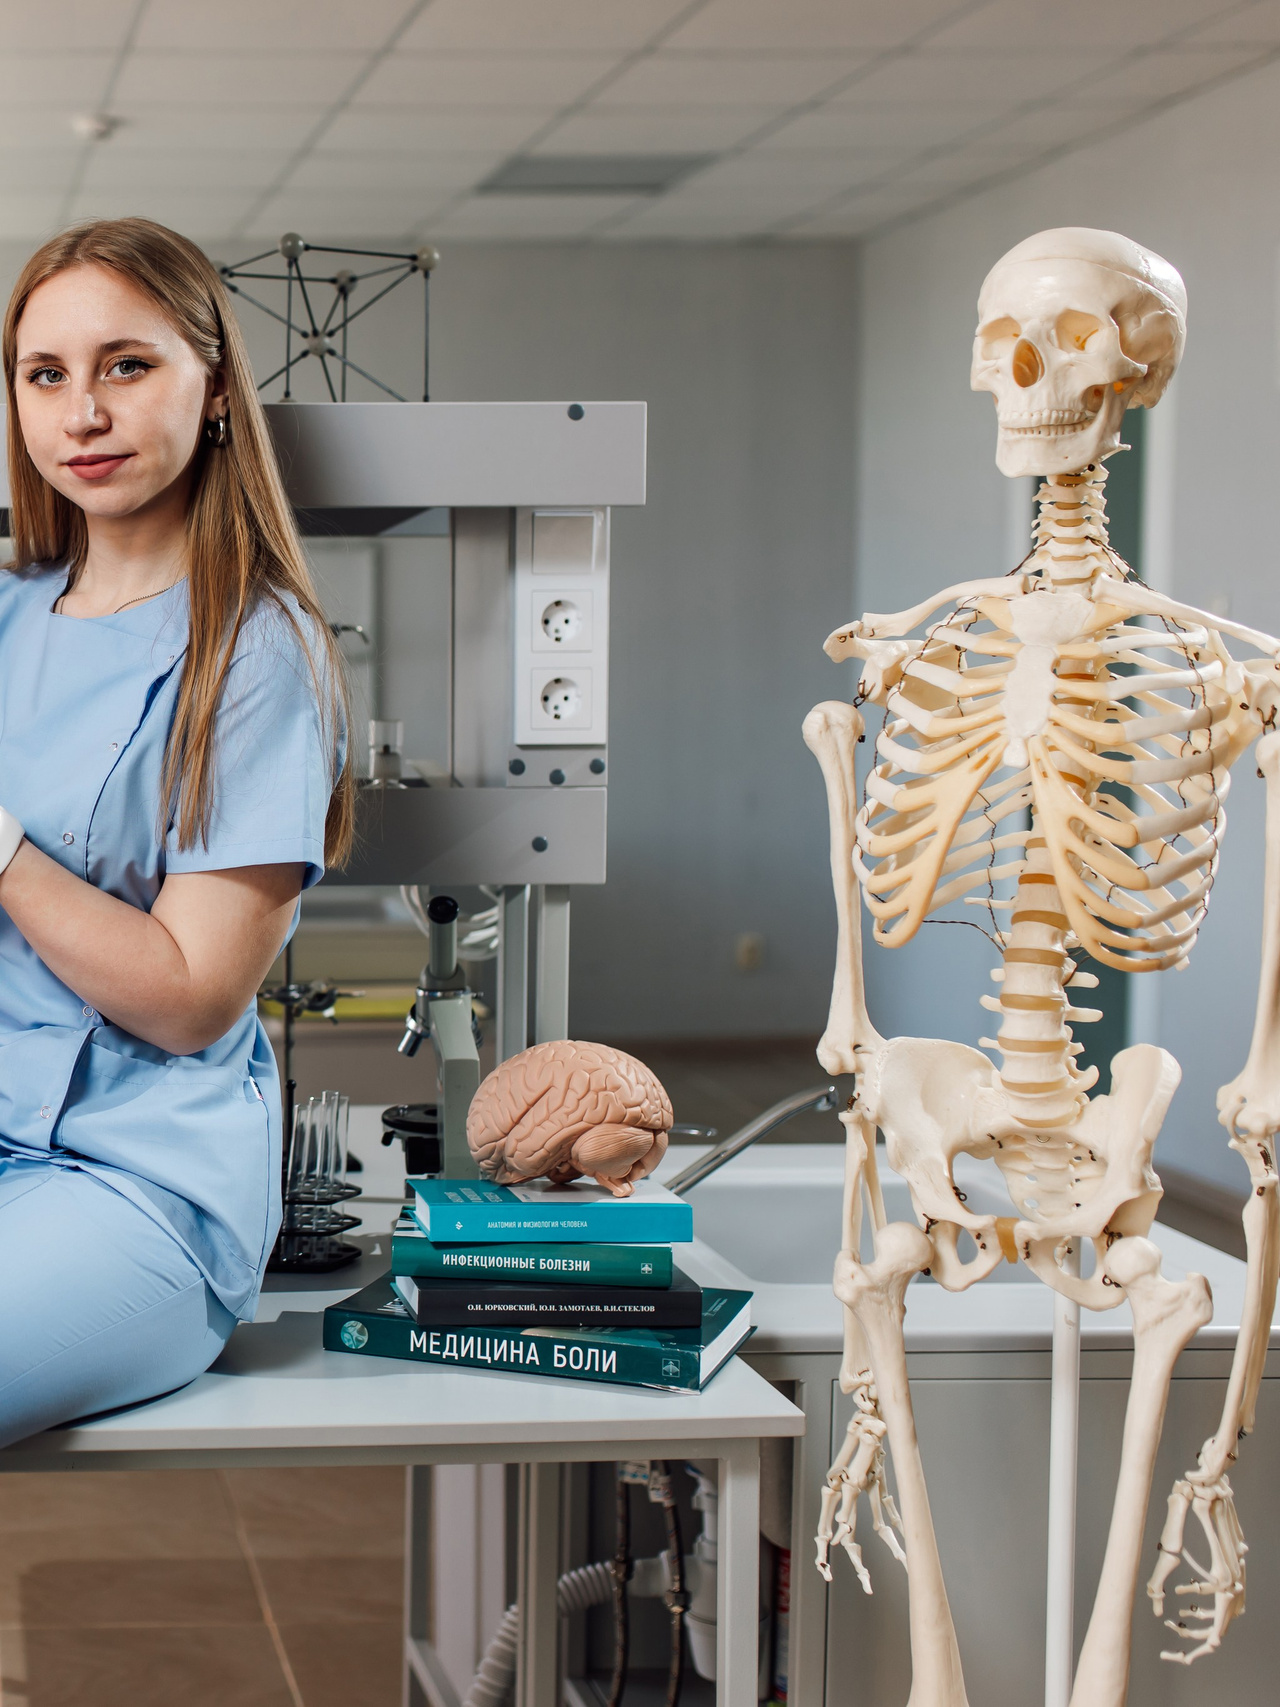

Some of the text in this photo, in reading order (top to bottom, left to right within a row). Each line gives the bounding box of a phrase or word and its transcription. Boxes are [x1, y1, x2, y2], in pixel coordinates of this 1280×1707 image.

[442, 1254, 591, 1272] ИНФЕКЦИОННЫЕ БОЛЕЗНИ
[484, 1303, 538, 1312] ЮРКОВСКИЙ,
[409, 1329, 617, 1374] МЕДИЦИНА БОЛИ
